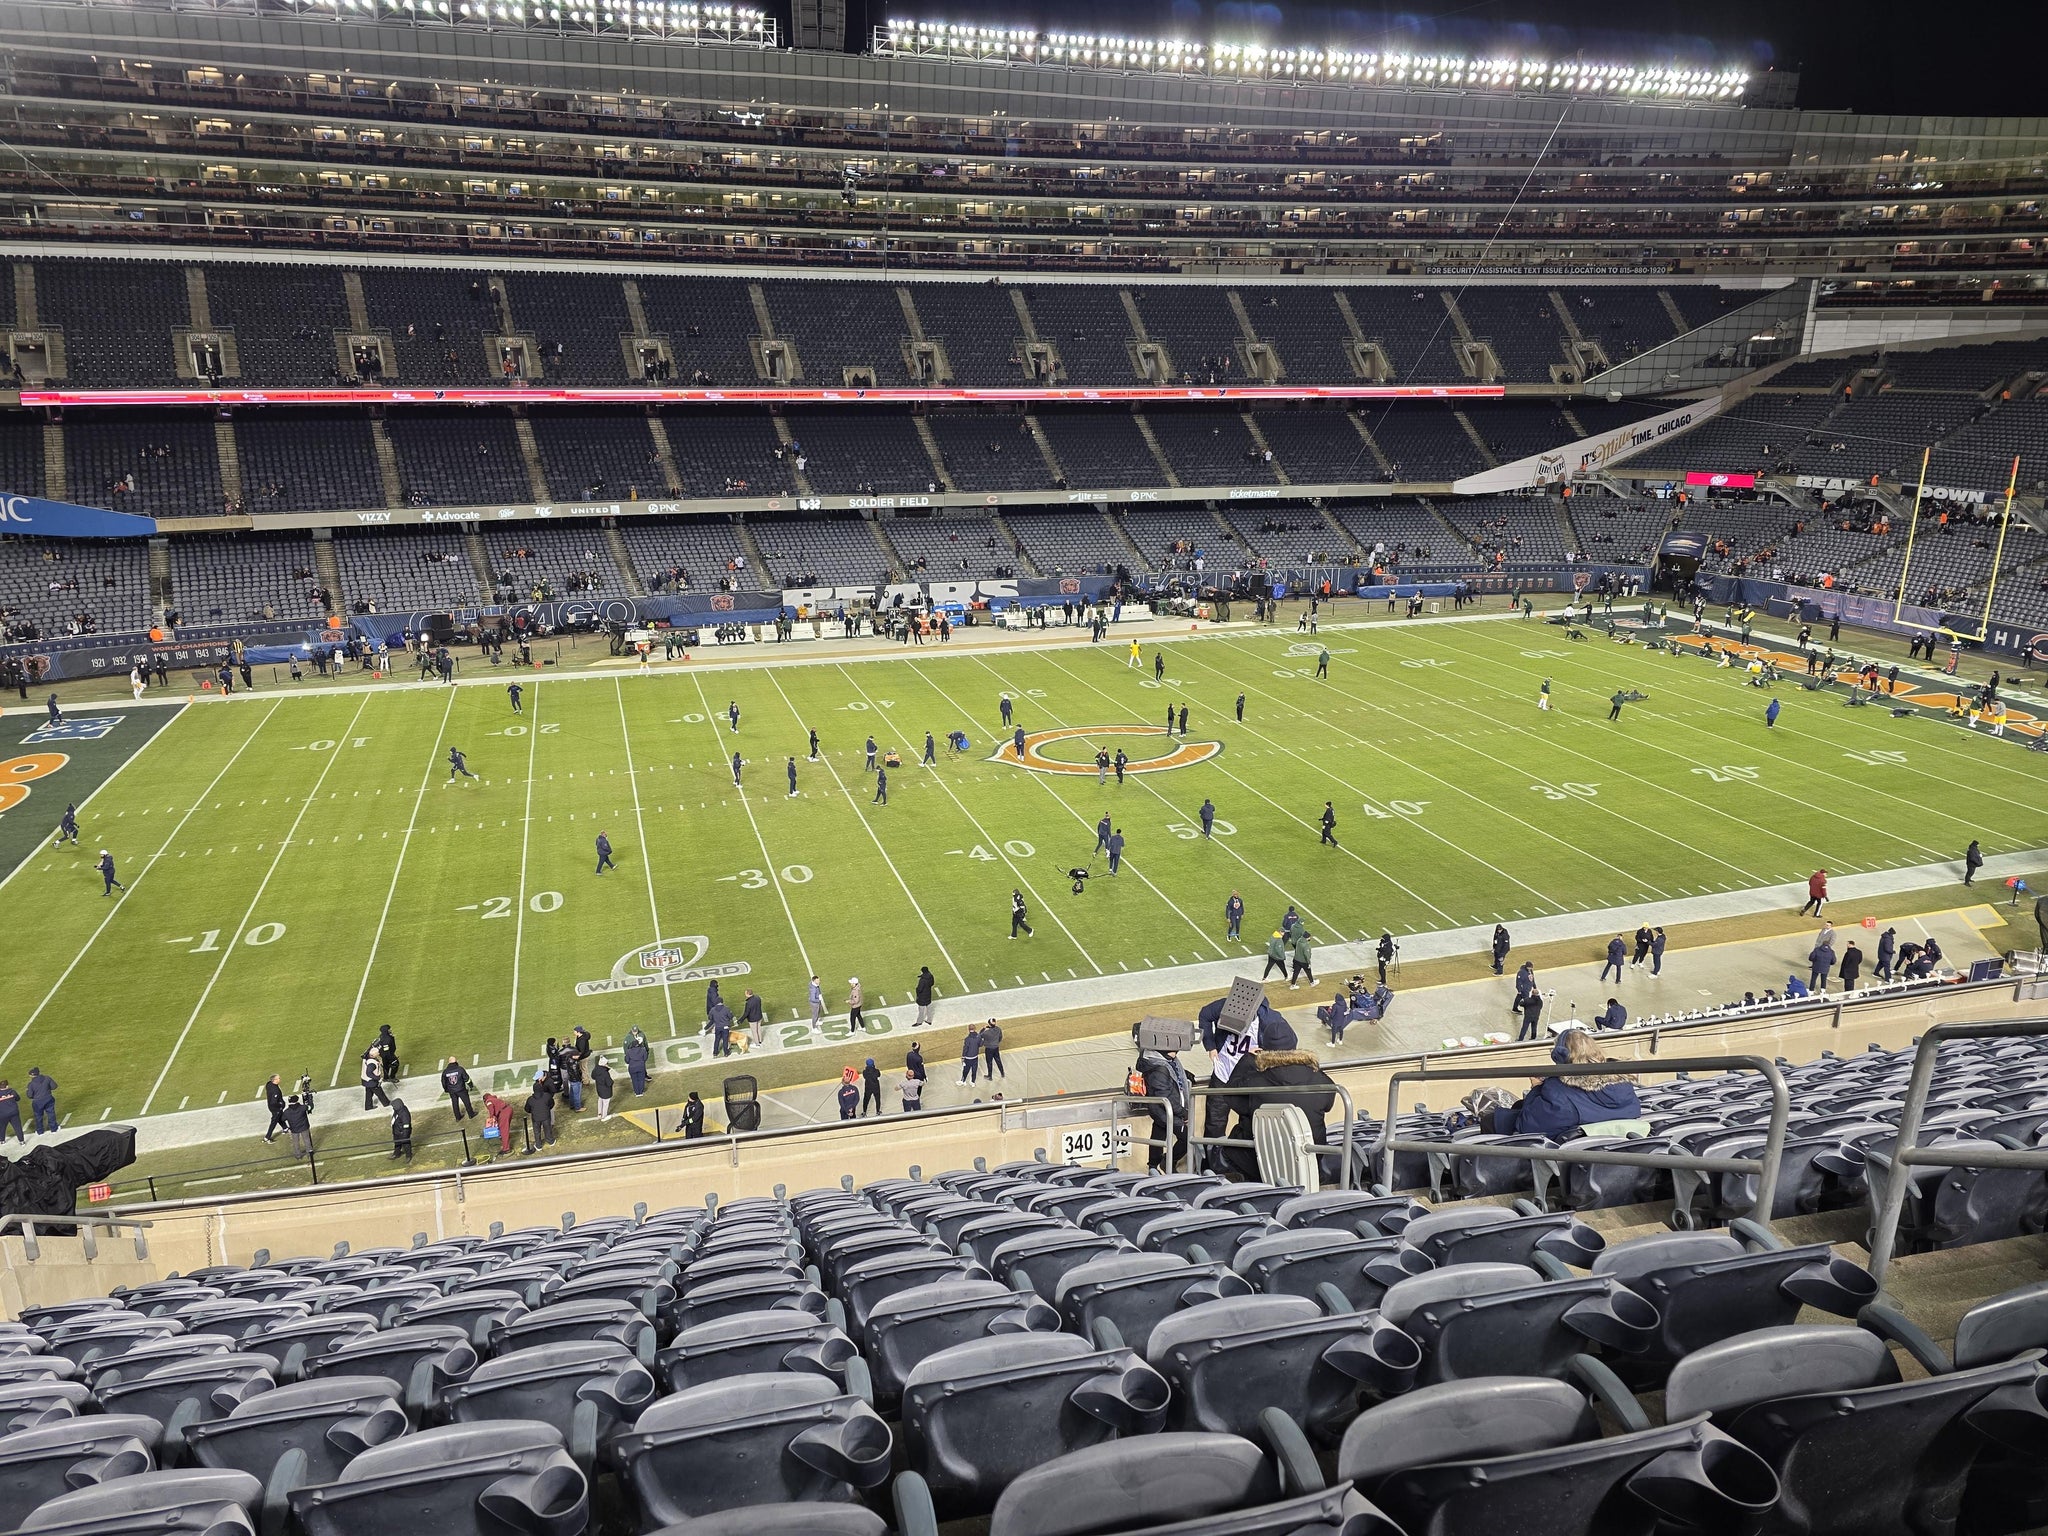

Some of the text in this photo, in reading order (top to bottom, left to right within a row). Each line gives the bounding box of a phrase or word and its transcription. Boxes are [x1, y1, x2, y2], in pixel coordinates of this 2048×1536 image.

[1581, 450, 1597, 465] IT'S
[1594, 426, 1637, 466] Miller
[1658, 413, 1692, 436] CHICAGO
[1796, 475, 1861, 490] BEAR
[1140, 492, 1158, 500] PNC
[1230, 489, 1280, 498] ticketmaster
[1920, 486, 1985, 503] DOWN
[659, 504, 680, 512] PNC
[849, 497, 929, 508] SOLDIER FIELD
[357, 513, 391, 521] VIZZY
[435, 511, 480, 520] Advocate
[782, 580, 1019, 613] BEARS
[182, 640, 230, 650] CHAMPIONS
[91, 658, 105, 668] 1921
[112, 656, 127, 666] 1932
[175, 651, 189, 660] 1941
[195, 649, 209, 658] 1943
[215, 647, 229, 657] 1946
[503, 723, 561, 737] 20
[308, 736, 373, 751] 10
[1842, 750, 1908, 765] 10
[1690, 765, 1760, 782] 20
[1529, 782, 1599, 800] 30
[1362, 800, 1424, 820] 40
[1165, 818, 1239, 841] 50
[967, 840, 1036, 862] 40
[740, 865, 814, 889] 30
[480, 891, 565, 920] 20
[1866, 918, 1876, 928] 30
[188, 922, 287, 953] 10
[646, 955, 678, 967] NFL
[587, 966, 740, 992] WILD CARD
[781, 1014, 893, 1048] 250
[1226, 1034, 1251, 1056] 34
[845, 1067, 854, 1081] 30
[1065, 1133, 1093, 1153] 340
